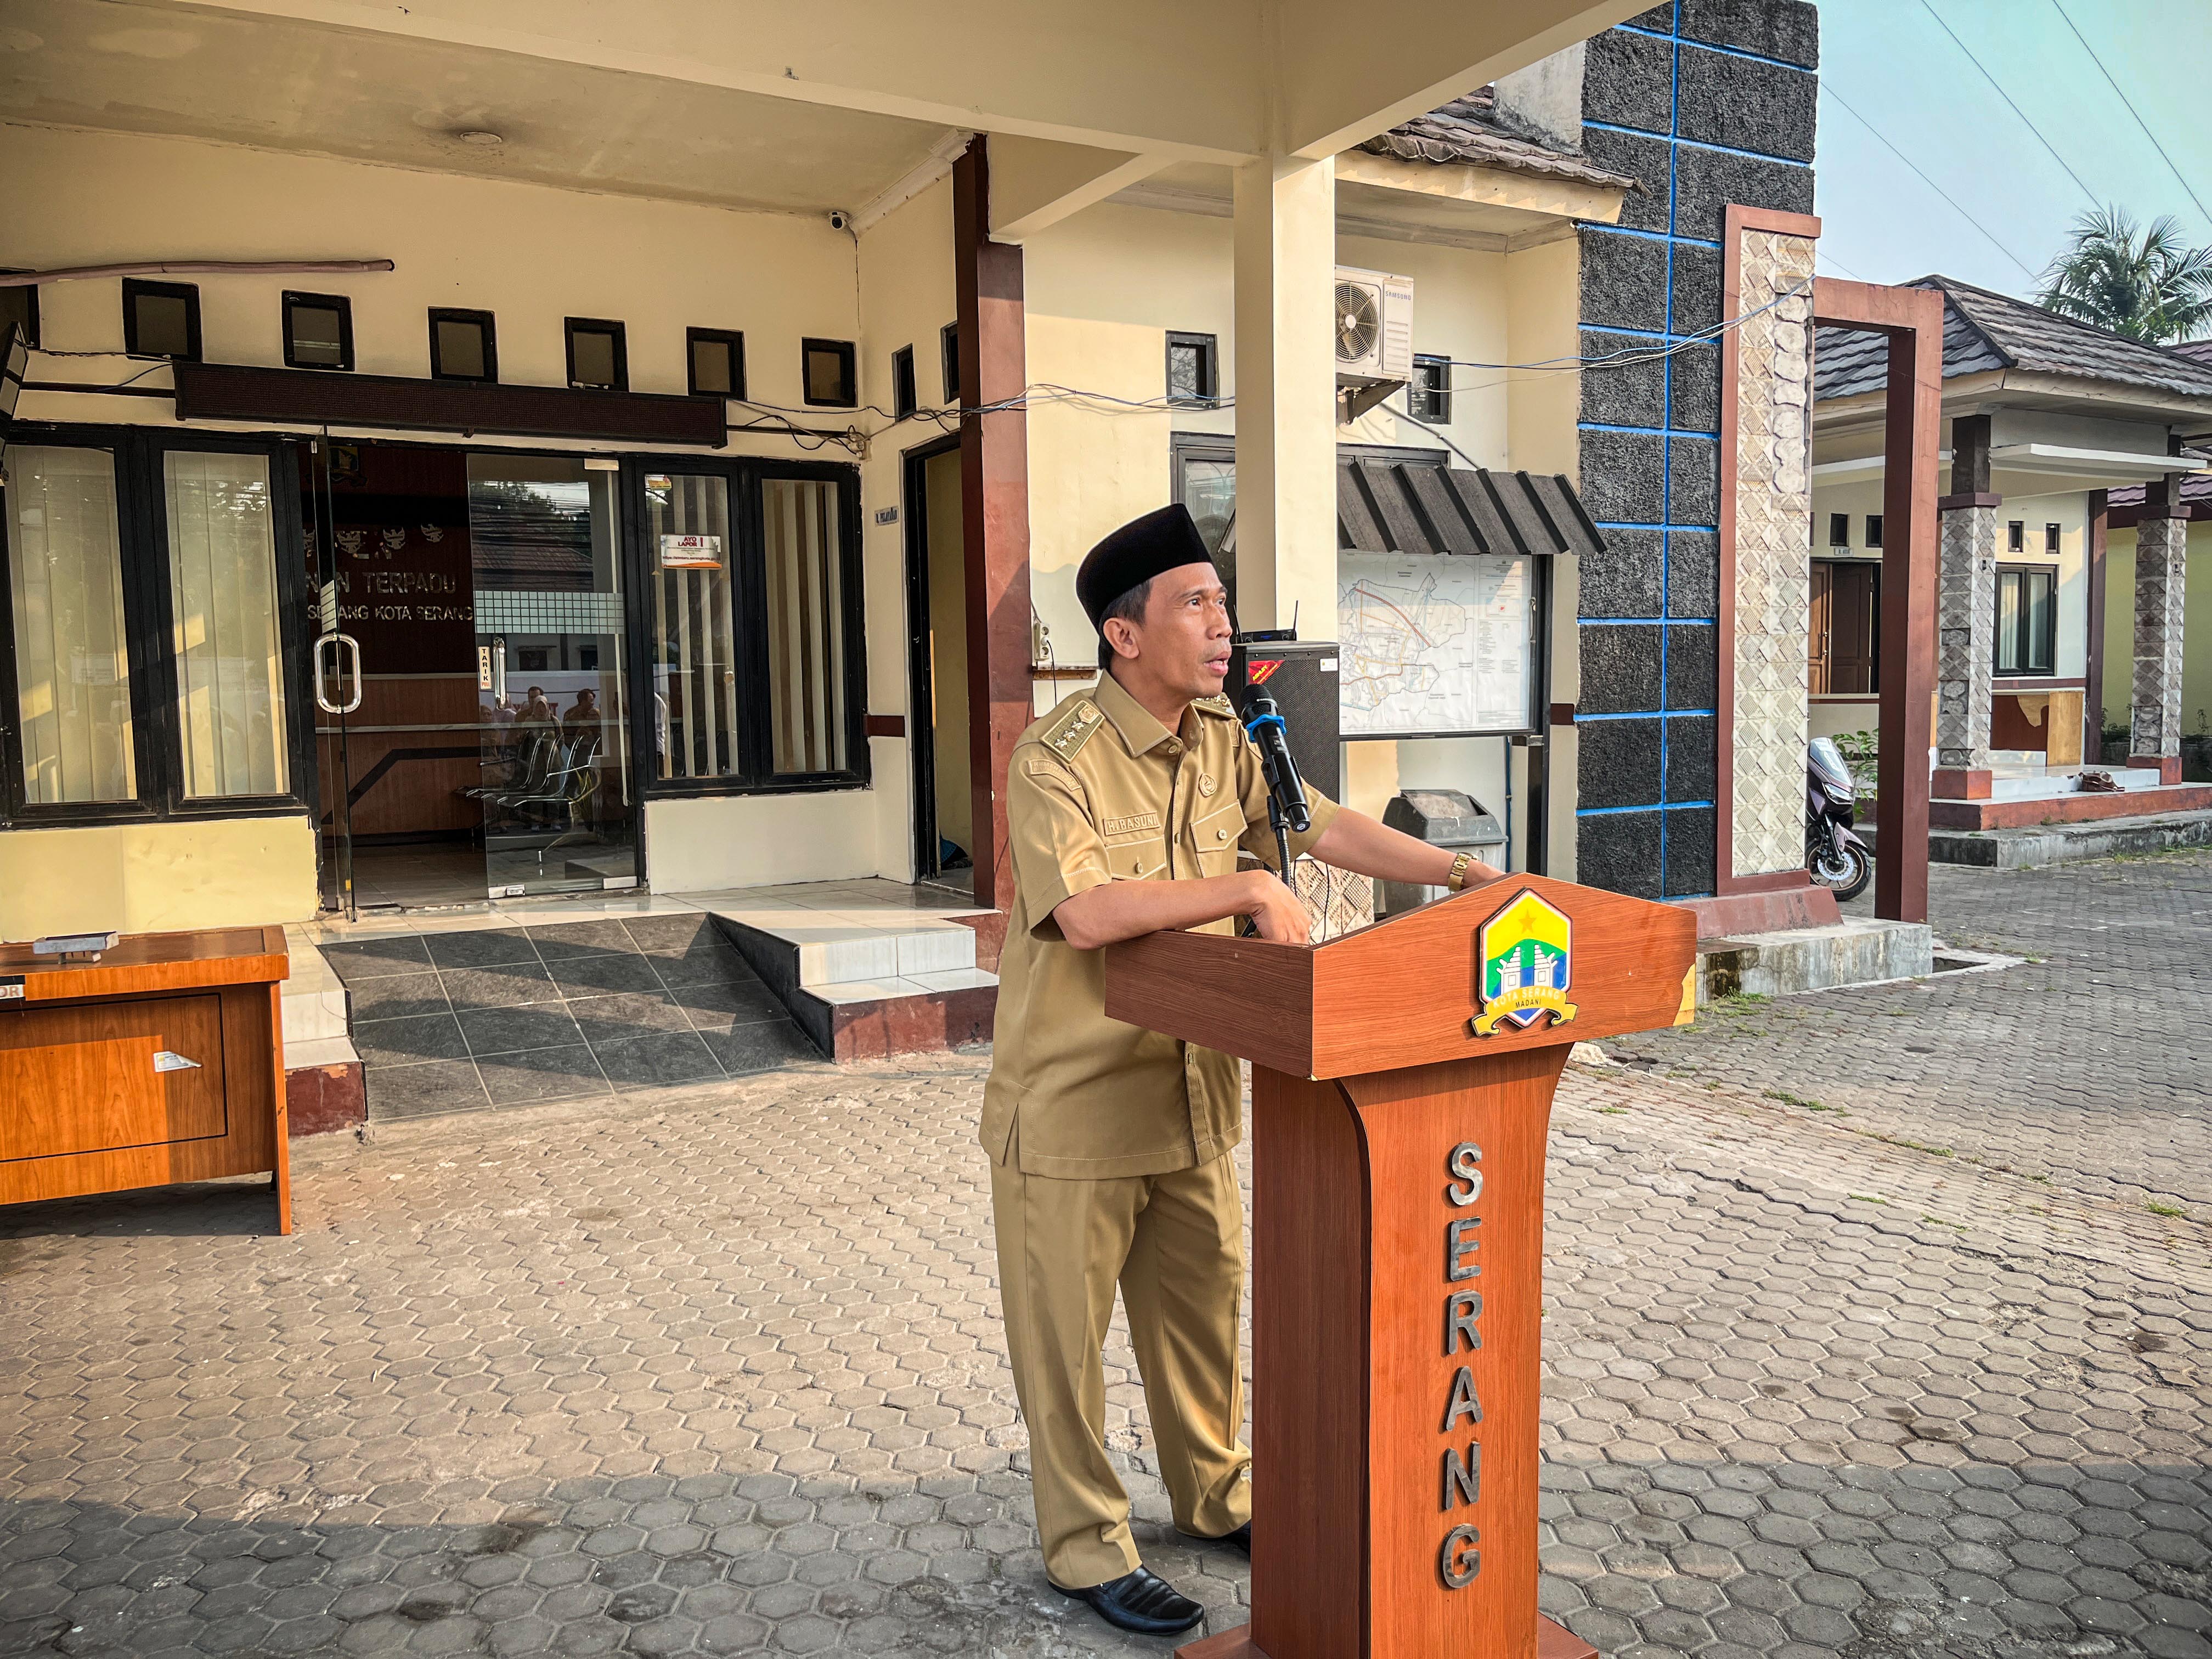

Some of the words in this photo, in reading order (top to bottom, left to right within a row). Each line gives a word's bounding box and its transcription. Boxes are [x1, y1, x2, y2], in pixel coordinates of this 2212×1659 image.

[1385, 291, 1412, 301] SAMSUNG
[362, 572, 457, 594] TERPADU
[375, 605, 412, 620] KOTA
[416, 606, 473, 621] SERANG
[1493, 991, 1519, 1008] KOTA
[1521, 988, 1560, 1000] SERANG
[1515, 998, 1542, 1008] MADANI
[1440, 1141, 1483, 1589] SERANG
